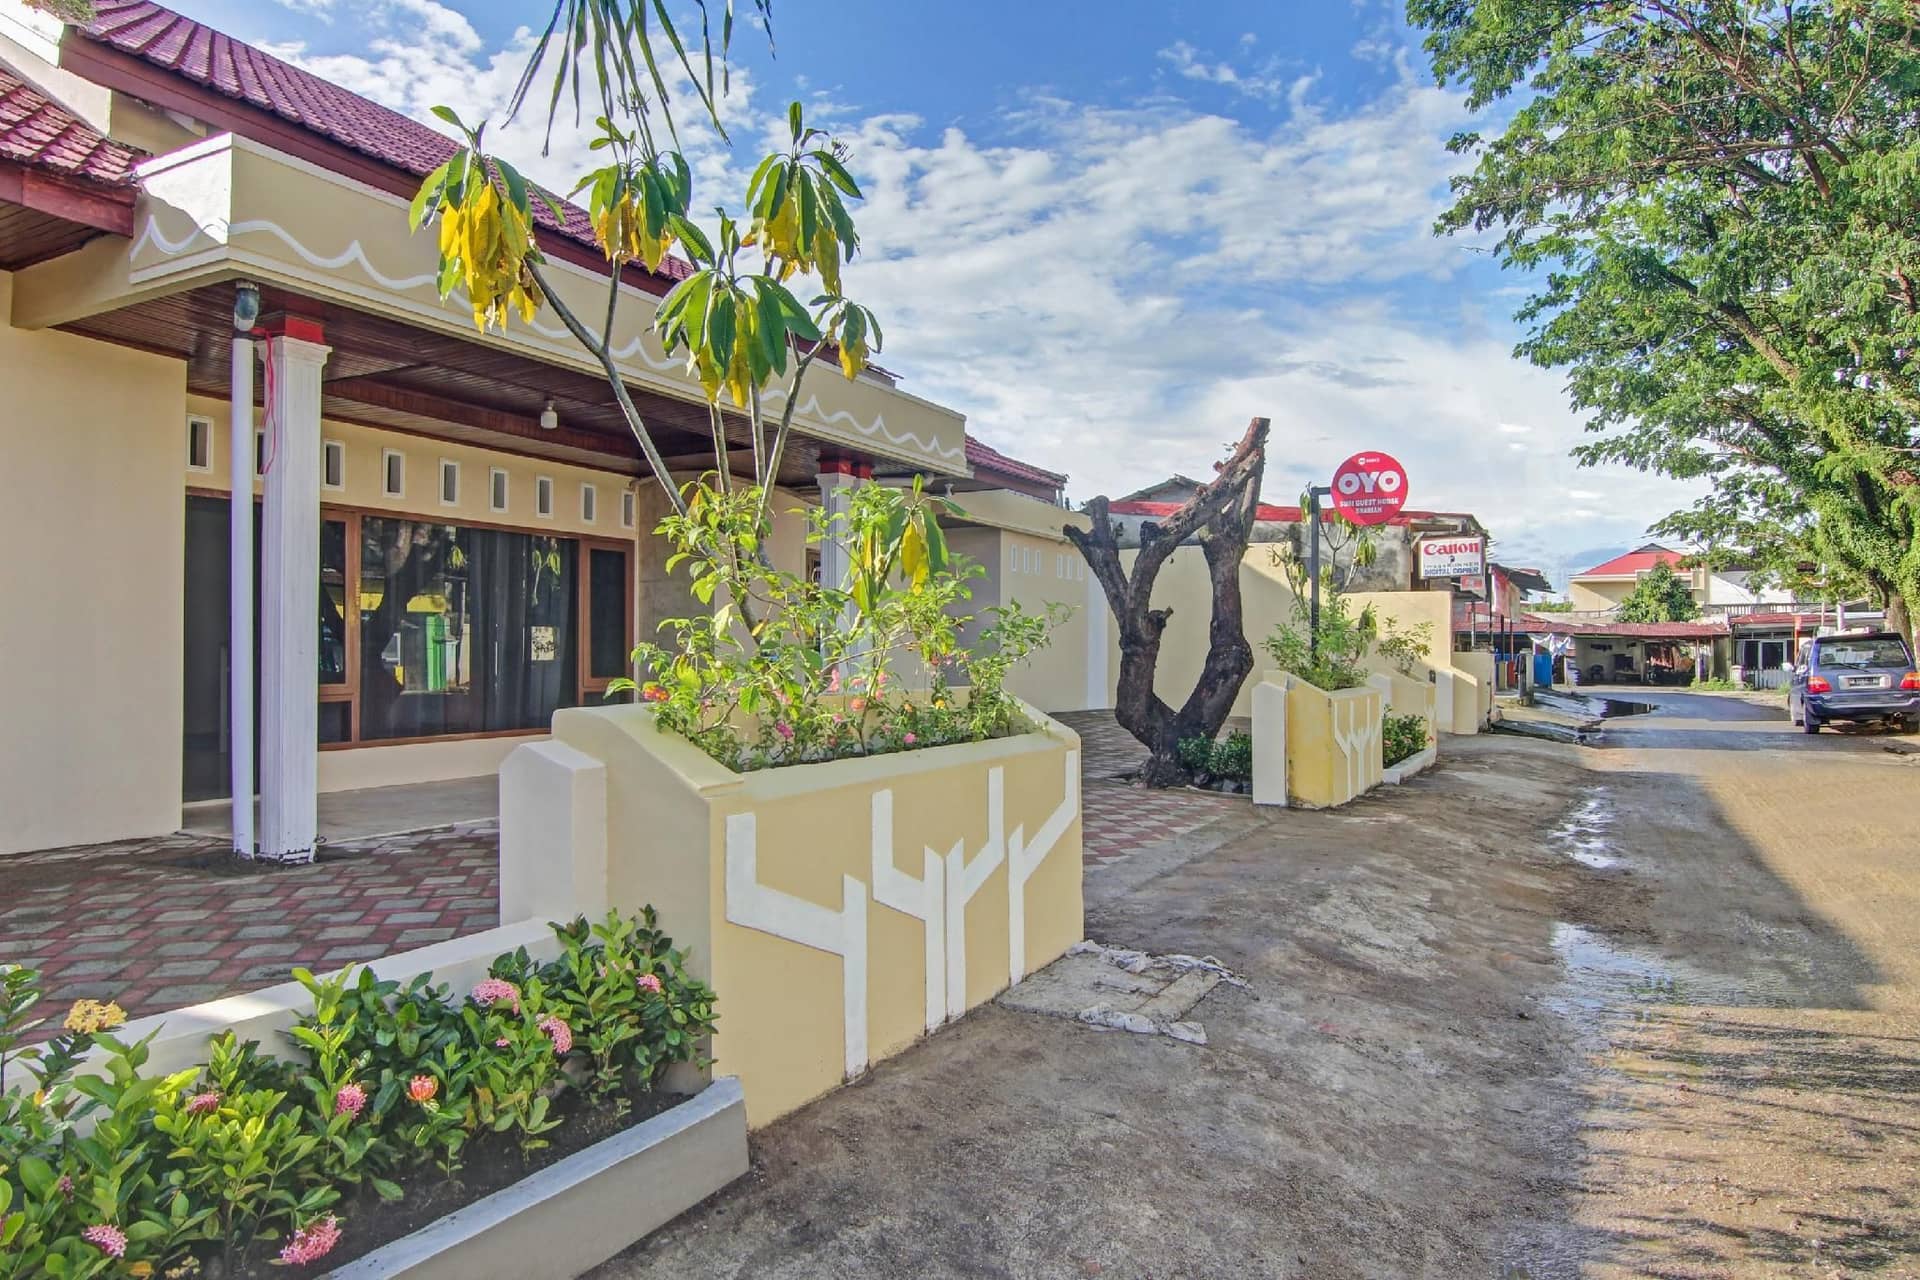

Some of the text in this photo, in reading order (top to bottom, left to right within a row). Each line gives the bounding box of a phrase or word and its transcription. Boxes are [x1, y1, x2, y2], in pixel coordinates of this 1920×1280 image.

[1338, 470, 1401, 495] OYO
[1355, 498, 1377, 507] GUEST
[1377, 497, 1399, 505] HOUSE
[1424, 542, 1480, 556] Canon
[1424, 568, 1451, 576] DIGITAL
